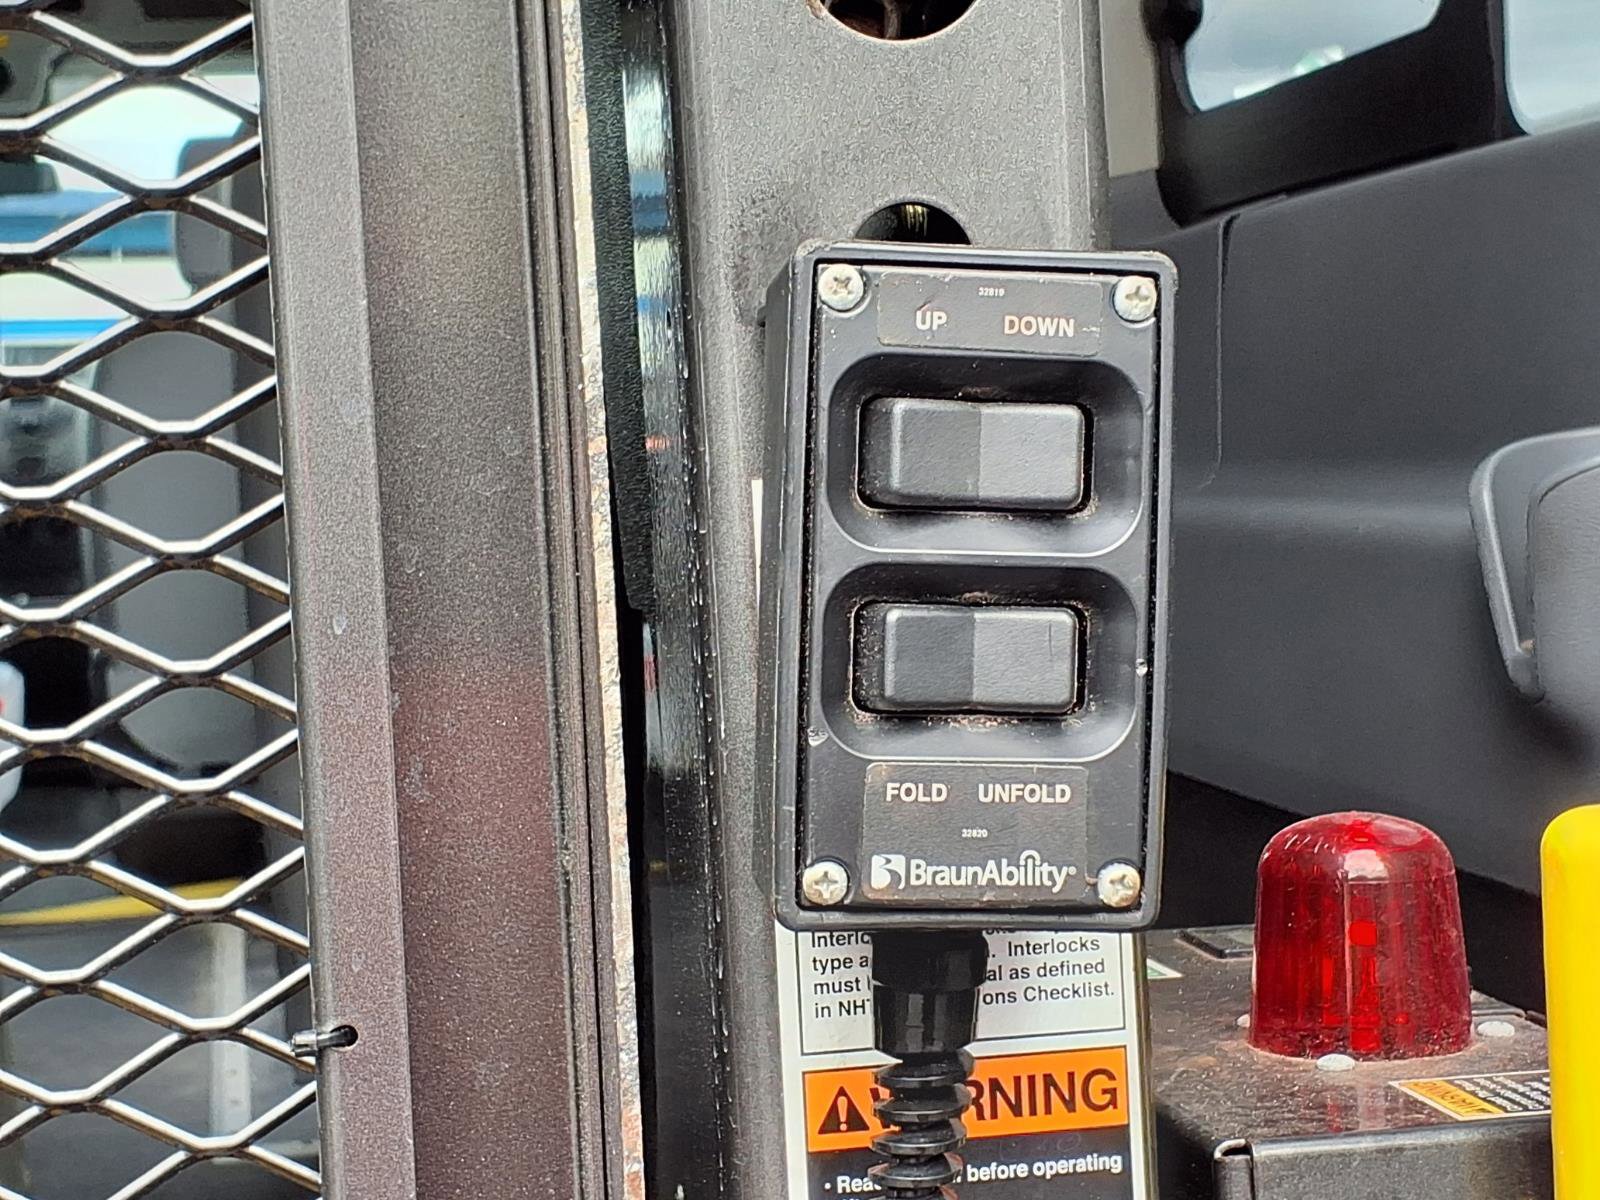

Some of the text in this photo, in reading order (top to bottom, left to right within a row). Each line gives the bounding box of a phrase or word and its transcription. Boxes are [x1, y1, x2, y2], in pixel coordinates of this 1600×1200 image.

[915, 310, 1075, 337] UP DOWN
[885, 782, 1072, 804] FOLD UNFOLD
[1007, 936, 1101, 957] Interlocks
[812, 956, 854, 975] type
[1009, 966, 1031, 981] as
[1036, 958, 1106, 978] defined
[813, 976, 862, 995] must
[1023, 981, 1115, 1003] Checklist.
[815, 1002, 832, 1019] in
[836, 1175, 882, 1194] Rea
[966, 1161, 1030, 1183] before
[1032, 1152, 1123, 1180] operating
